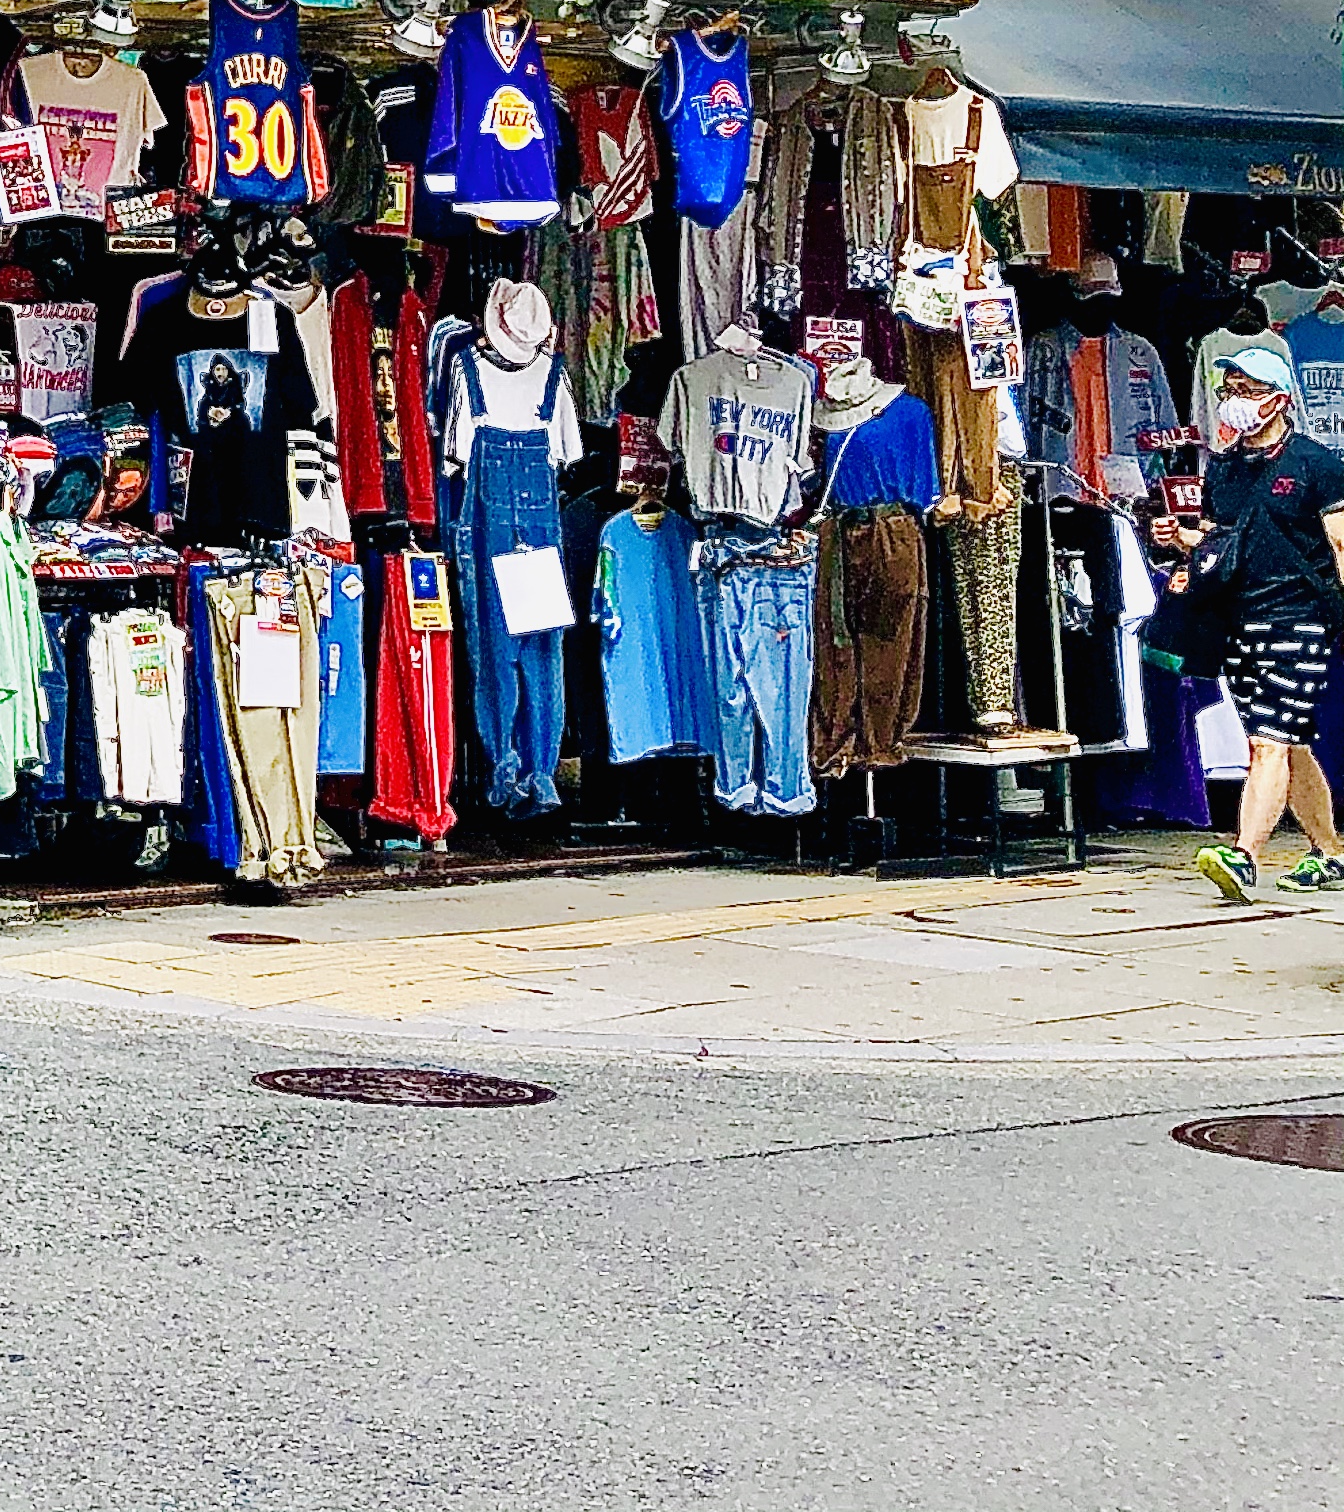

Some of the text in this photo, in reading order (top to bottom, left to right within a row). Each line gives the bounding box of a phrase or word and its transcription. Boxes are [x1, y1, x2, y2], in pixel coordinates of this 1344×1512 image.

[223, 96, 298, 181] 30
[708, 396, 797, 443] NEW YORK
[1149, 425, 1194, 449] SALE
